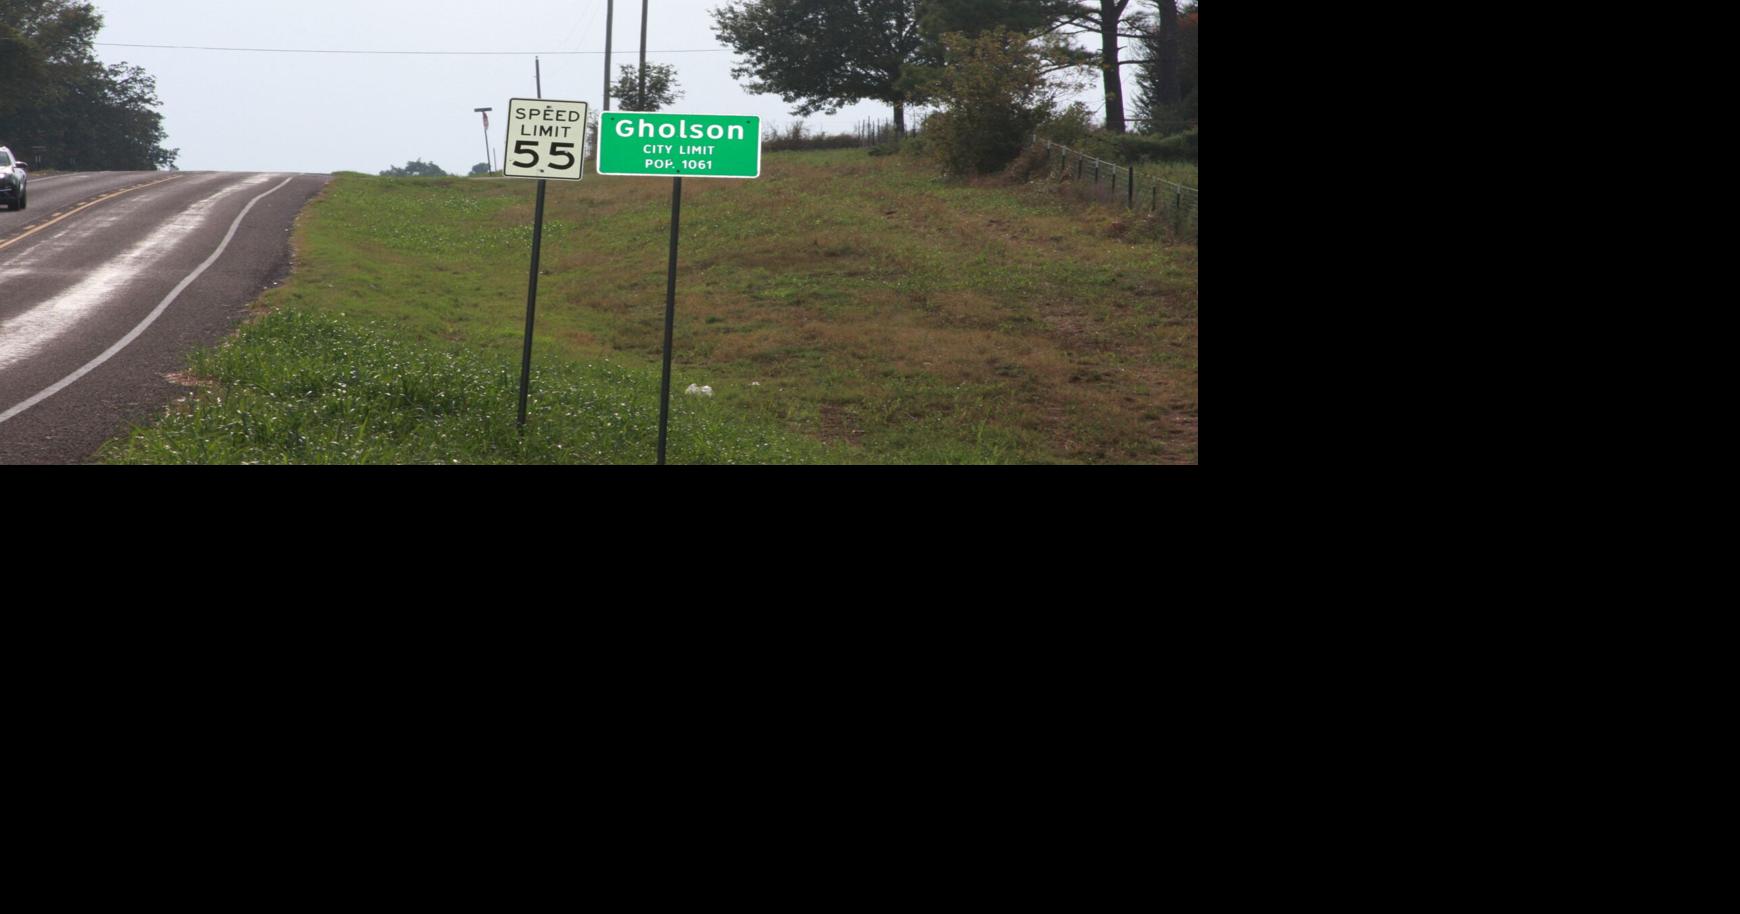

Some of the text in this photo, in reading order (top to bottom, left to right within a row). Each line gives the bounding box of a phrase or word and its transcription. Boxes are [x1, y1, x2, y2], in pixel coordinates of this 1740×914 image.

[515, 107, 580, 122] SPEED
[520, 124, 571, 138] LIMIT
[615, 119, 744, 140] Gholson
[512, 140, 575, 170] 55
[643, 144, 715, 156] CITY LIMIT
[682, 159, 713, 170] 1061
